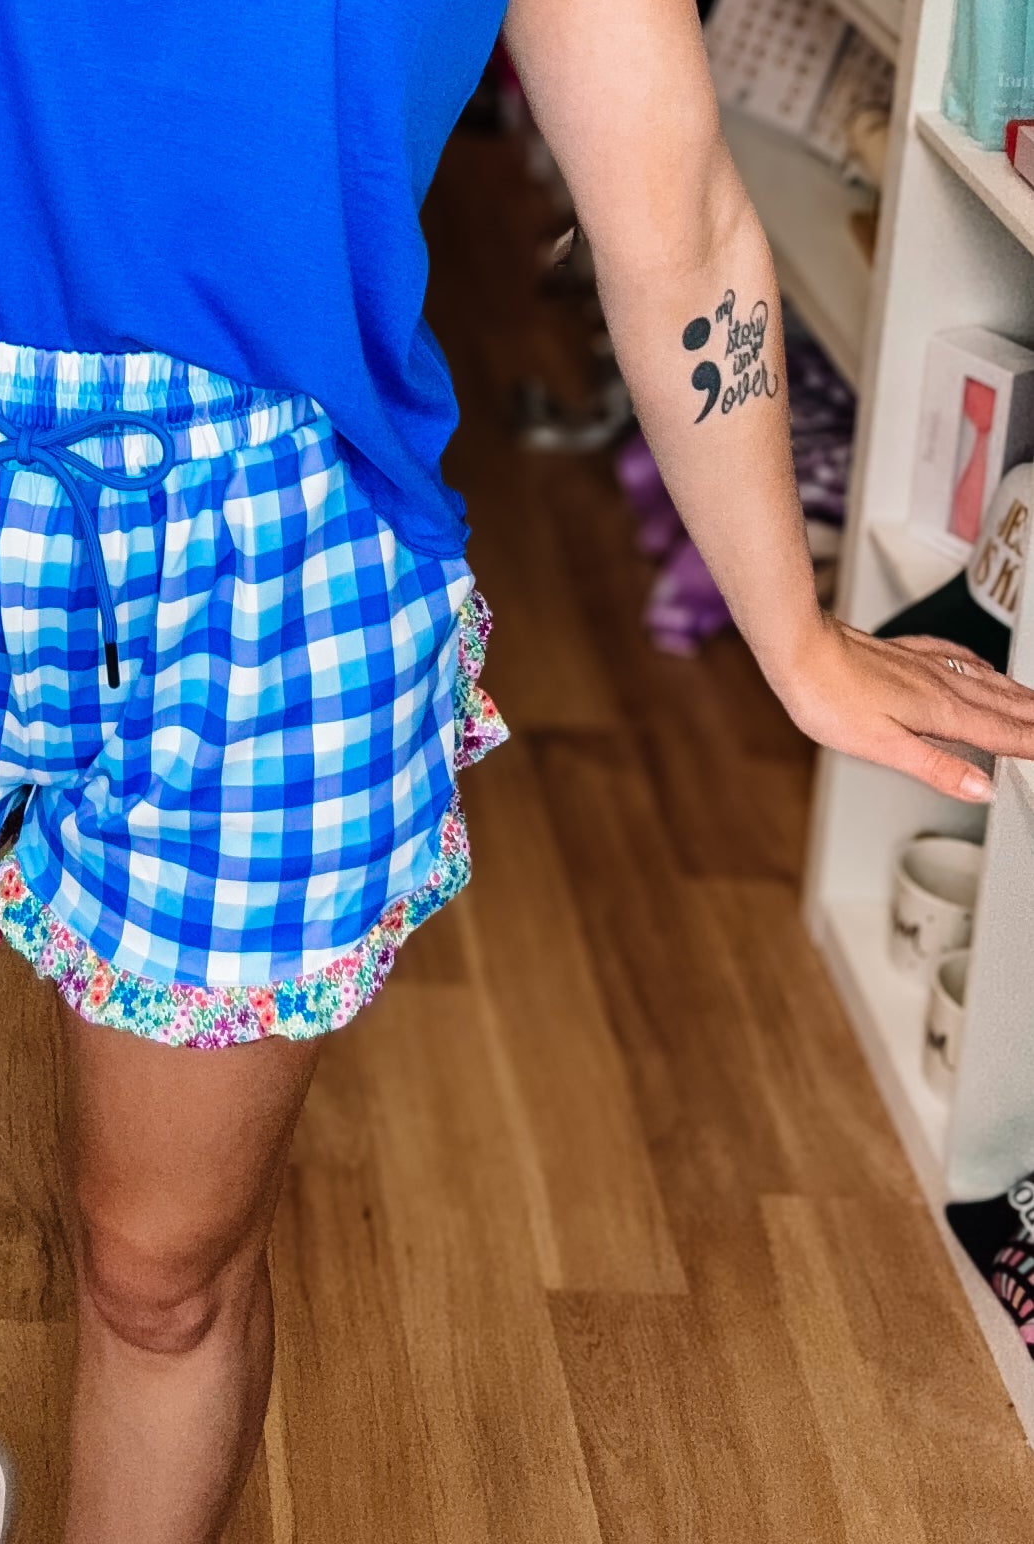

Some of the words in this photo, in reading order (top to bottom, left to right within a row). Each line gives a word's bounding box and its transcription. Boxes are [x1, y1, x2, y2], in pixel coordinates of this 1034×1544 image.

[715, 288, 735, 326] my
[724, 300, 768, 361] story
[721, 360, 778, 414] over
